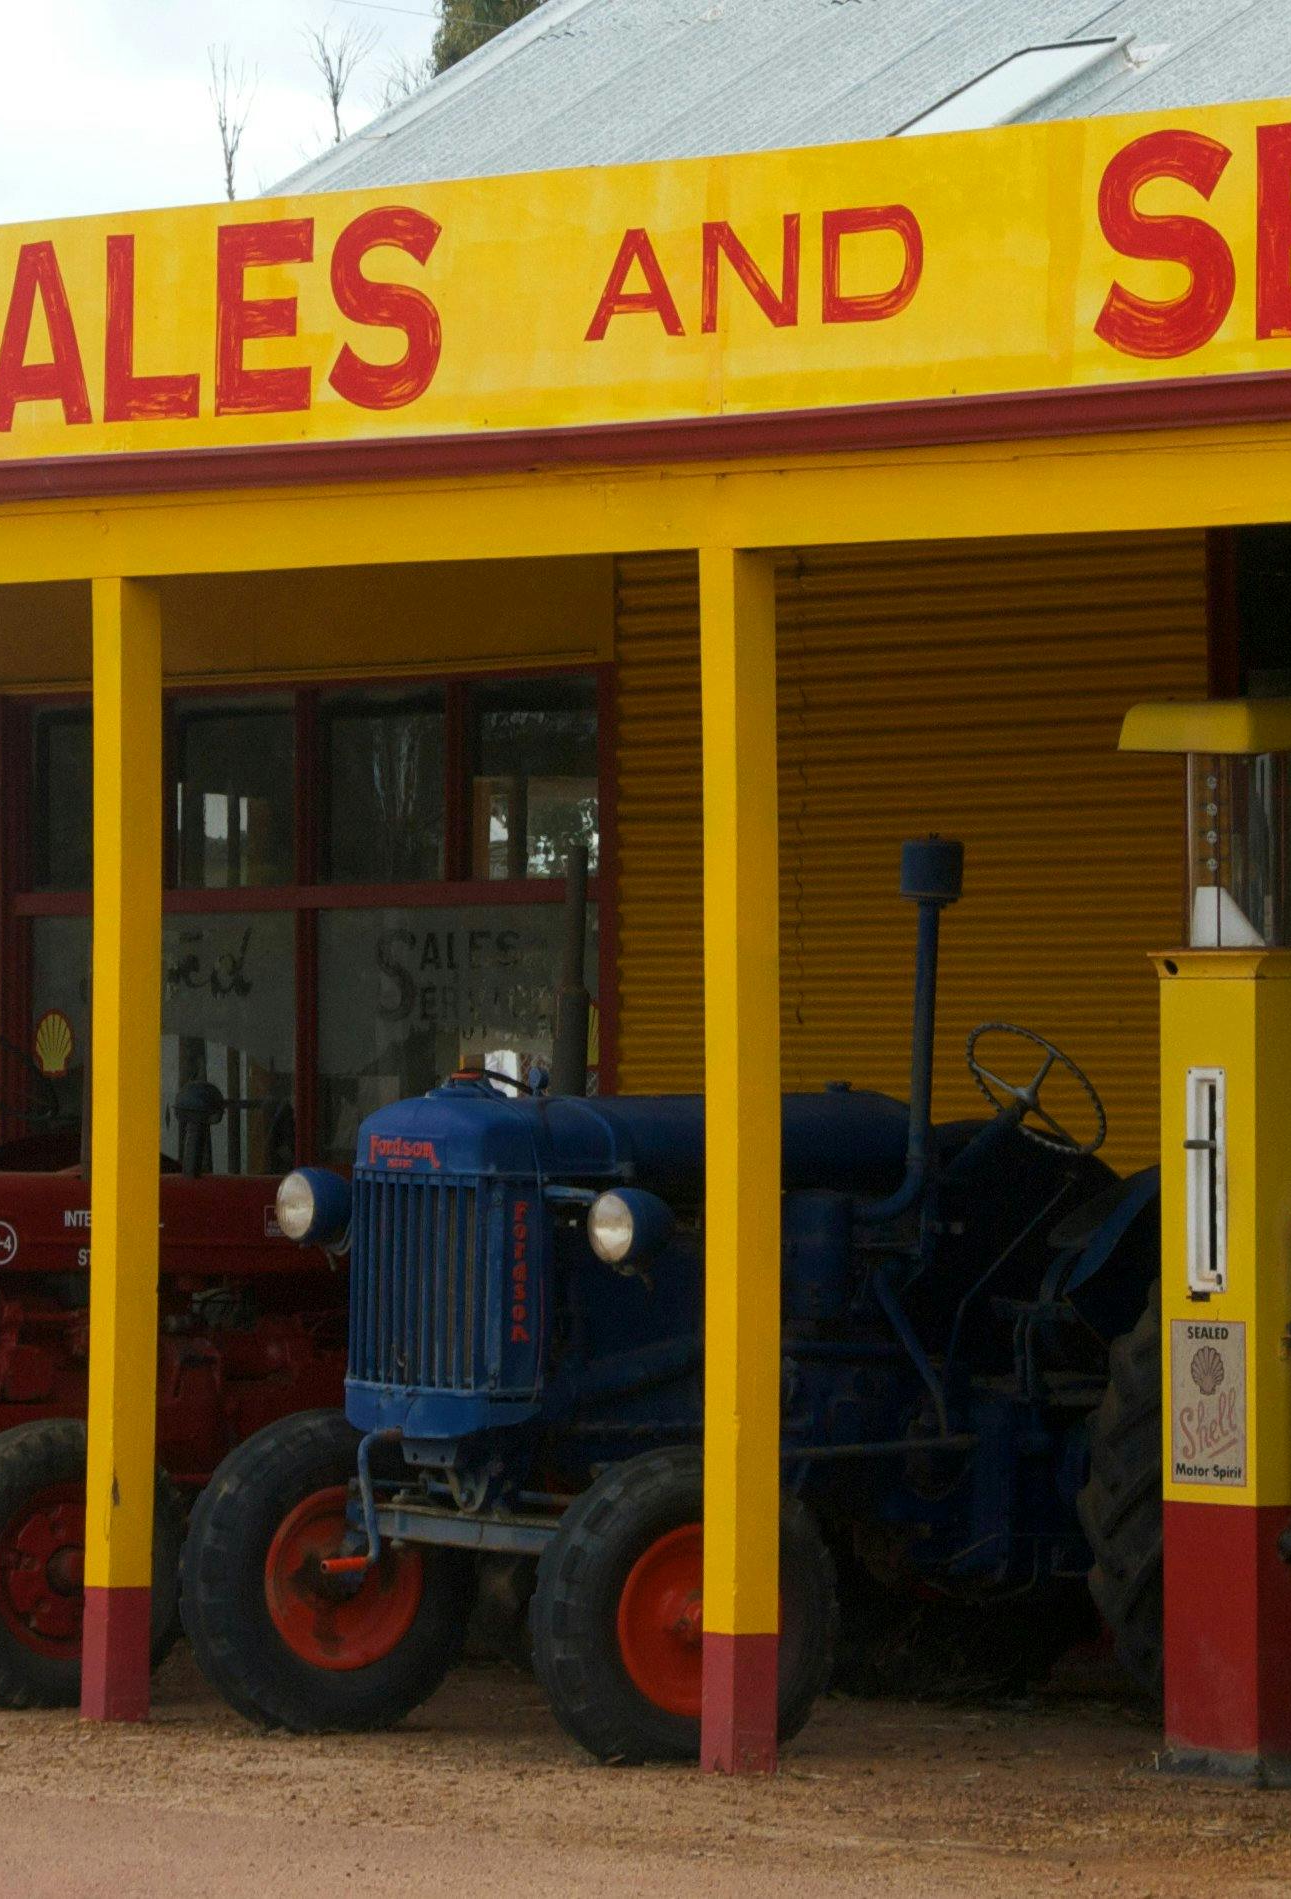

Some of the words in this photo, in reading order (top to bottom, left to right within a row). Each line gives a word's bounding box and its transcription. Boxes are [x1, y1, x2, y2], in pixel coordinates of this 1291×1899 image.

[585, 204, 924, 342] AND
[369, 1135, 441, 1168] Fordson
[1187, 1325, 1229, 1341] SEALED
[1179, 1387, 1238, 1459] Shell
[1175, 1463, 1210, 1477] Motor
[1212, 1464, 1243, 1480] Spirit
